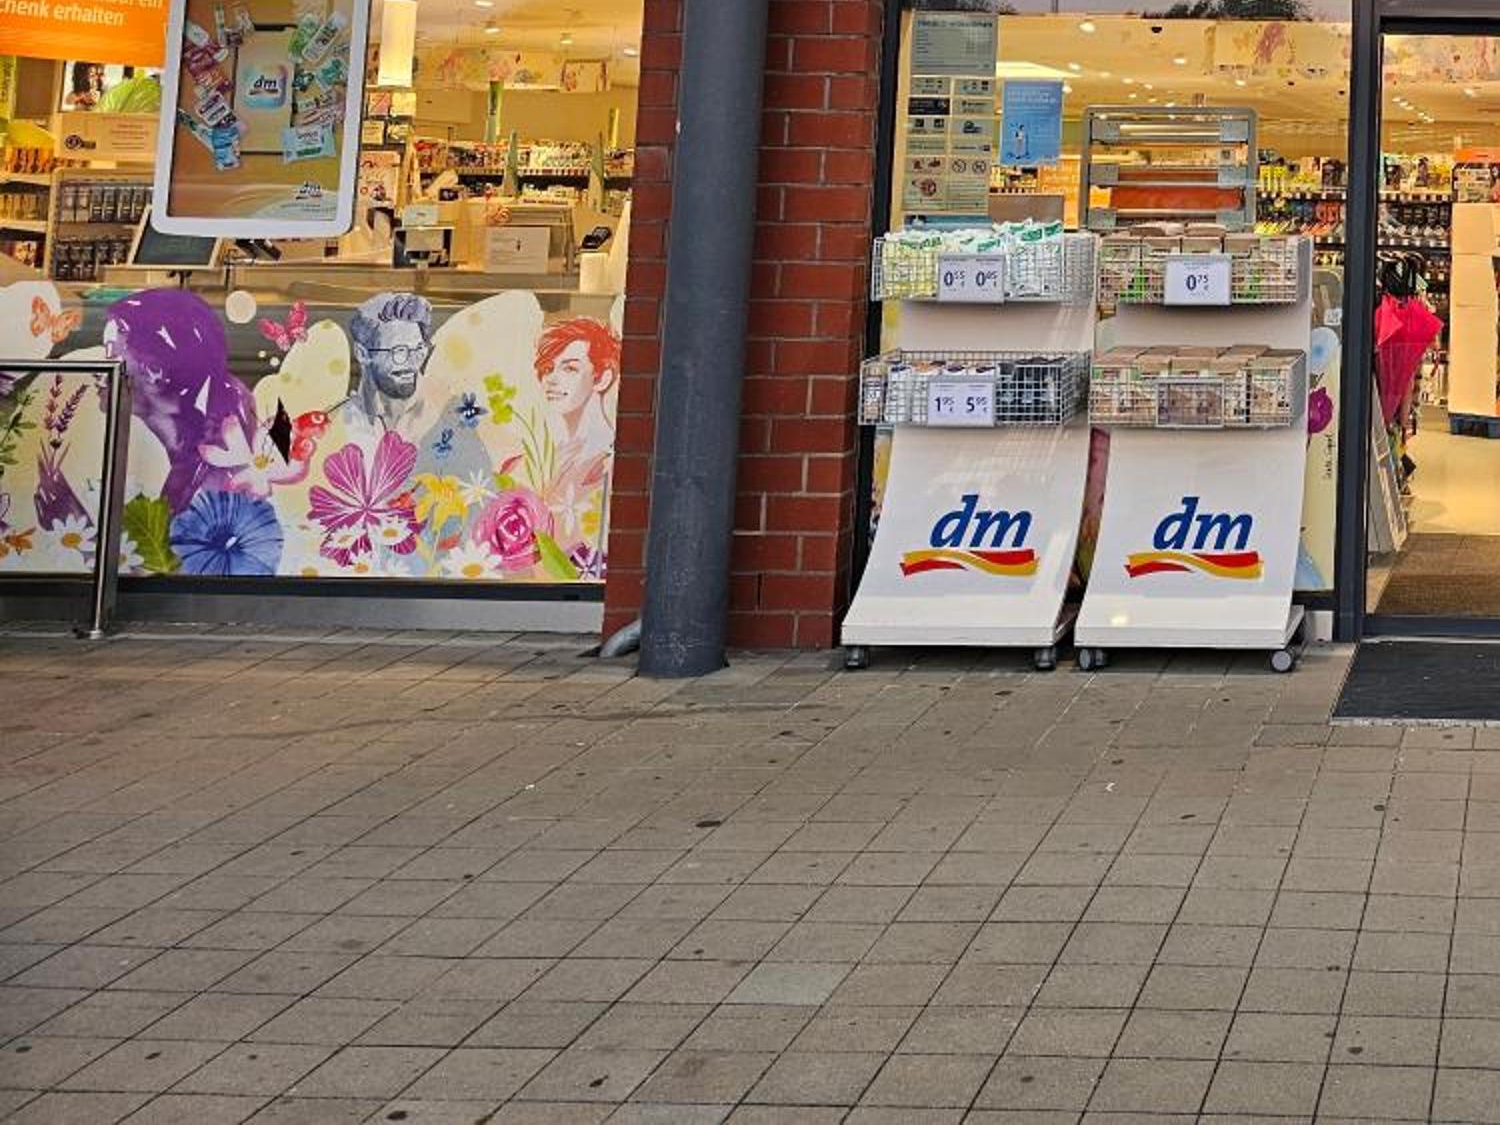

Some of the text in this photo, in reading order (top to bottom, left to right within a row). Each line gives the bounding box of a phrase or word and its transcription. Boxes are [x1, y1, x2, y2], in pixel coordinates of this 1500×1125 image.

[53, 3, 125, 27] erhalten
[930, 494, 1033, 549] dm
[1152, 496, 1254, 551] dm
